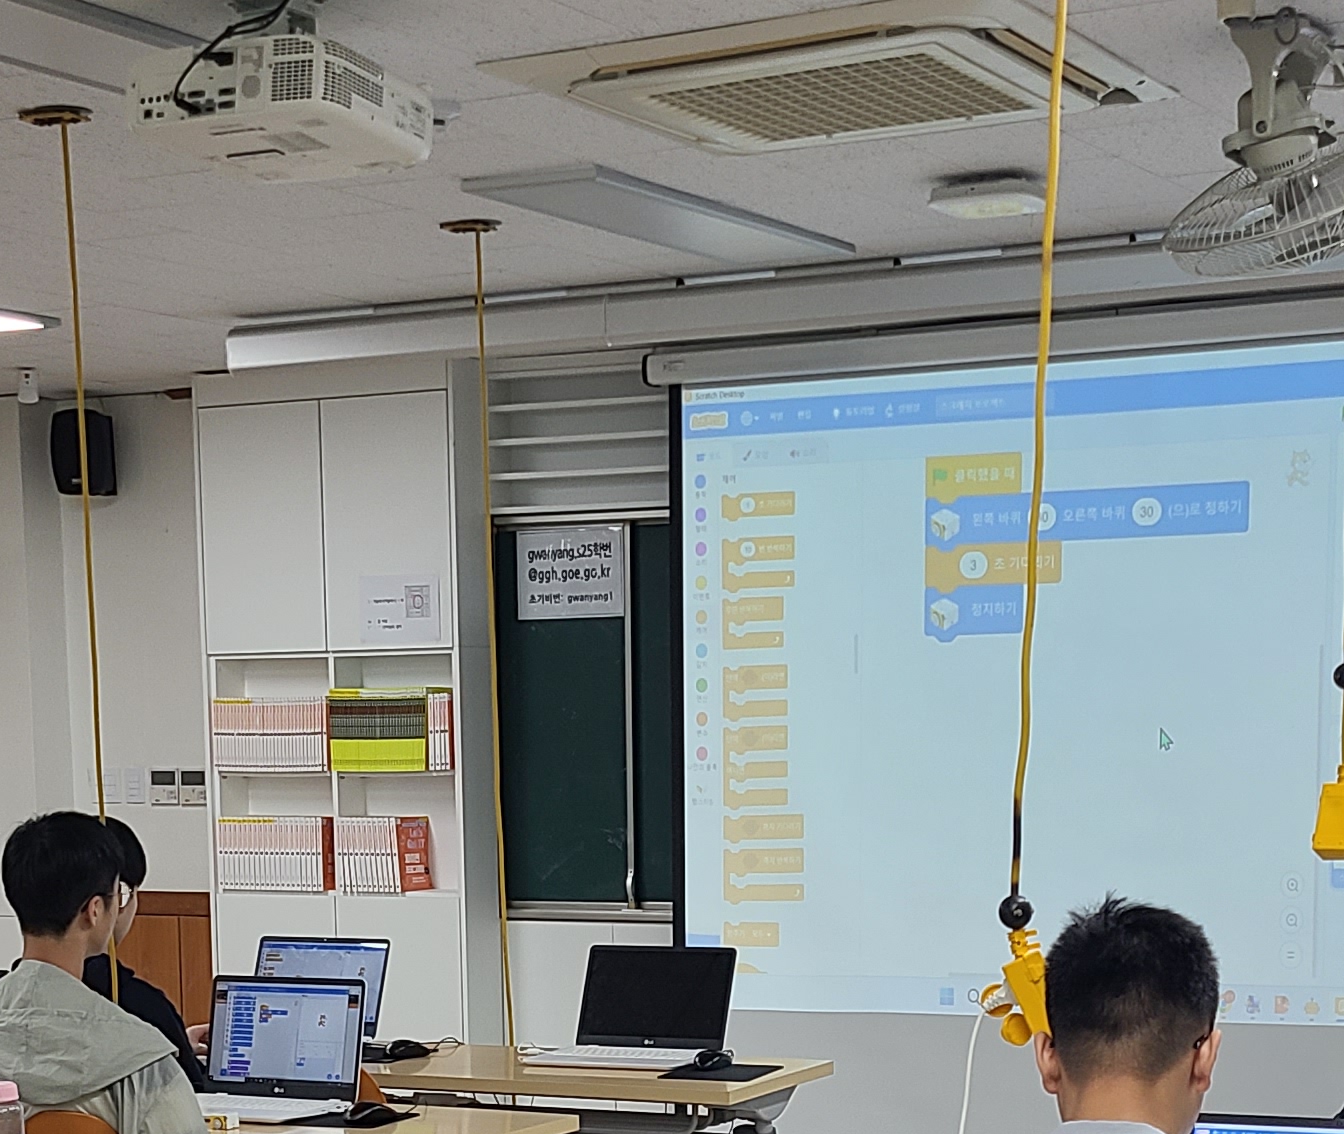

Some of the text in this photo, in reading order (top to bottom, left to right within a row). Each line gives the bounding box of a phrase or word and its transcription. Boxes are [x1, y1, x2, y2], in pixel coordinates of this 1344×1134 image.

[696, 392, 717, 400] Scratch
[954, 465, 1016, 483] 클릭했을 때
[972, 511, 995, 526] 왼쪽
[999, 510, 1021, 525] 바퀴
[1063, 508, 1097, 522] 오른쪽
[1102, 506, 1126, 521] 바퀴
[1139, 506, 1154, 518] 30
[1168, 502, 1202, 519] (으)로
[1205, 500, 1243, 516] 정하기
[969, 559, 977, 571] 3
[994, 557, 1006, 570] 초
[971, 602, 1017, 617] 정지하기
